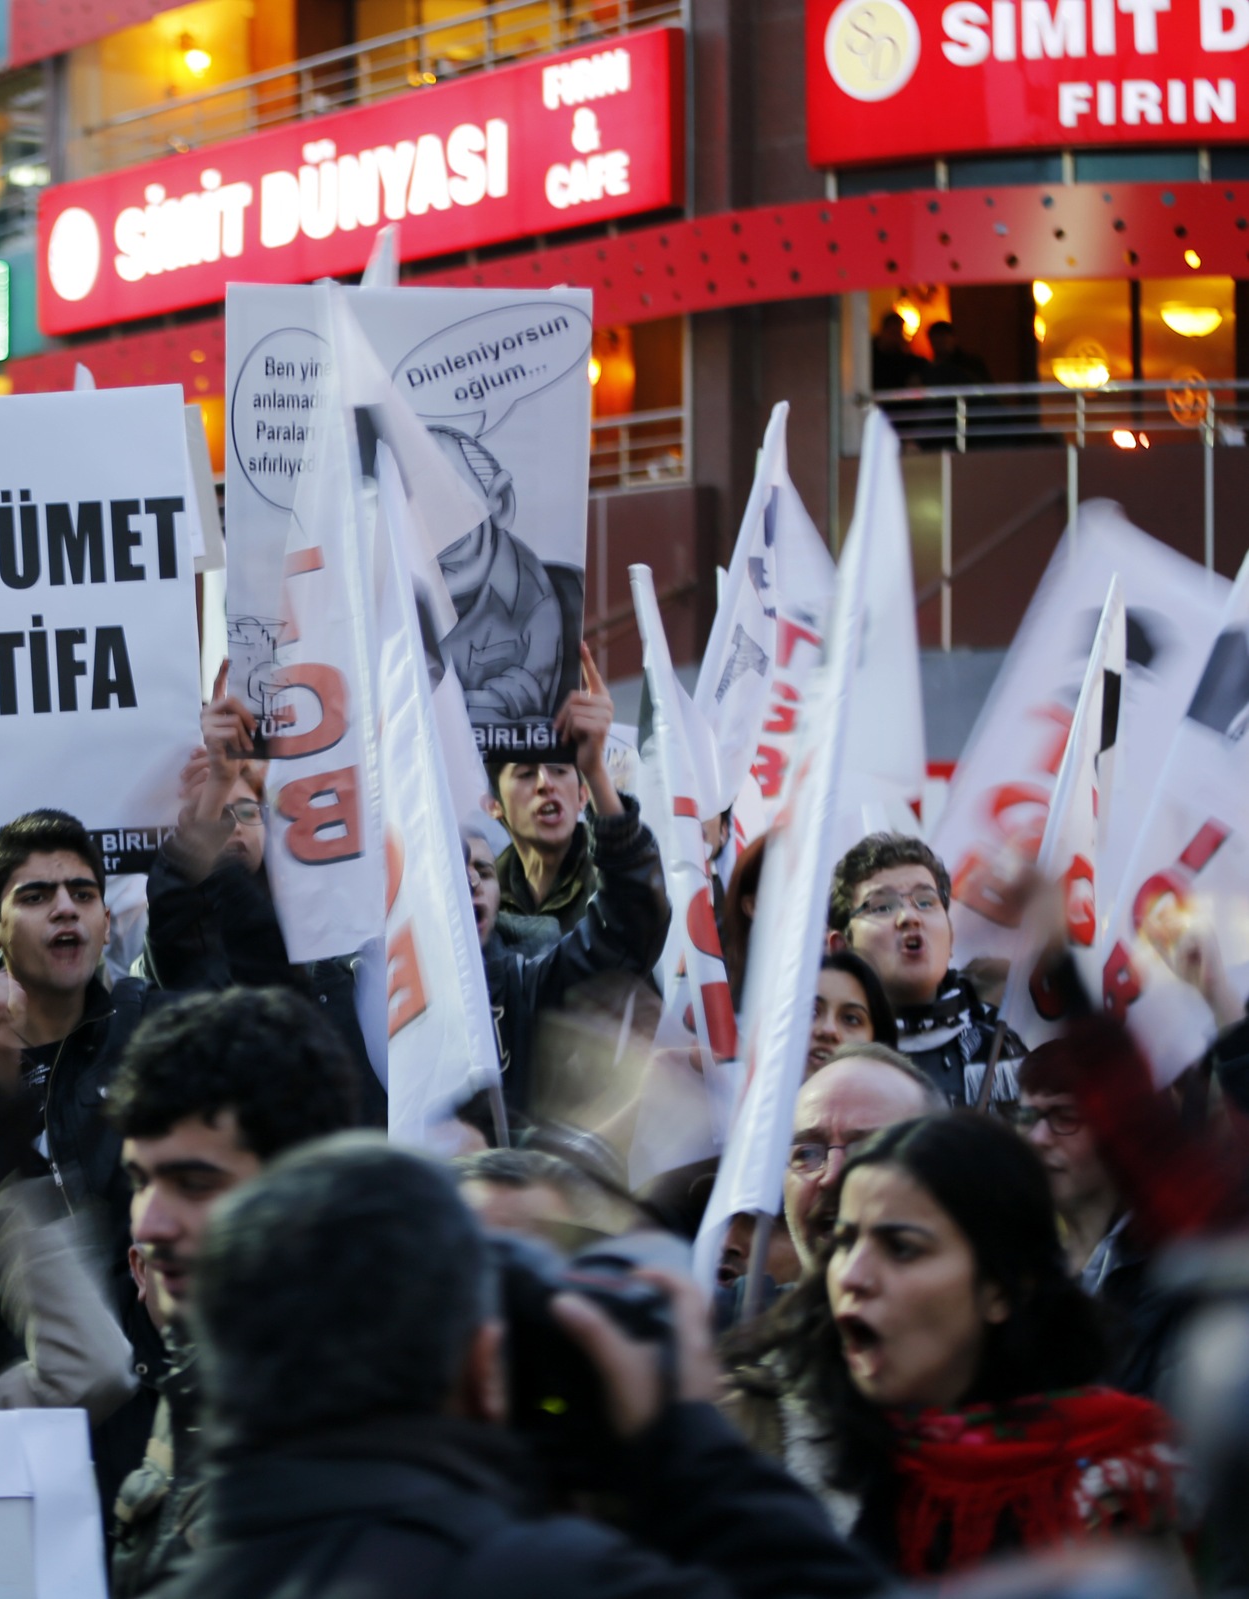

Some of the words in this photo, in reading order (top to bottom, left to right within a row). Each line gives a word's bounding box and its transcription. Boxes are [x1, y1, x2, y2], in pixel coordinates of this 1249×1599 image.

[1057, 78, 1237, 128] FIRIN
[260, 117, 508, 249] DÜNYASI
[545, 149, 630, 209] CAFE
[264, 355, 296, 378] Ben
[406, 315, 570, 389] Dinleniyorsun
